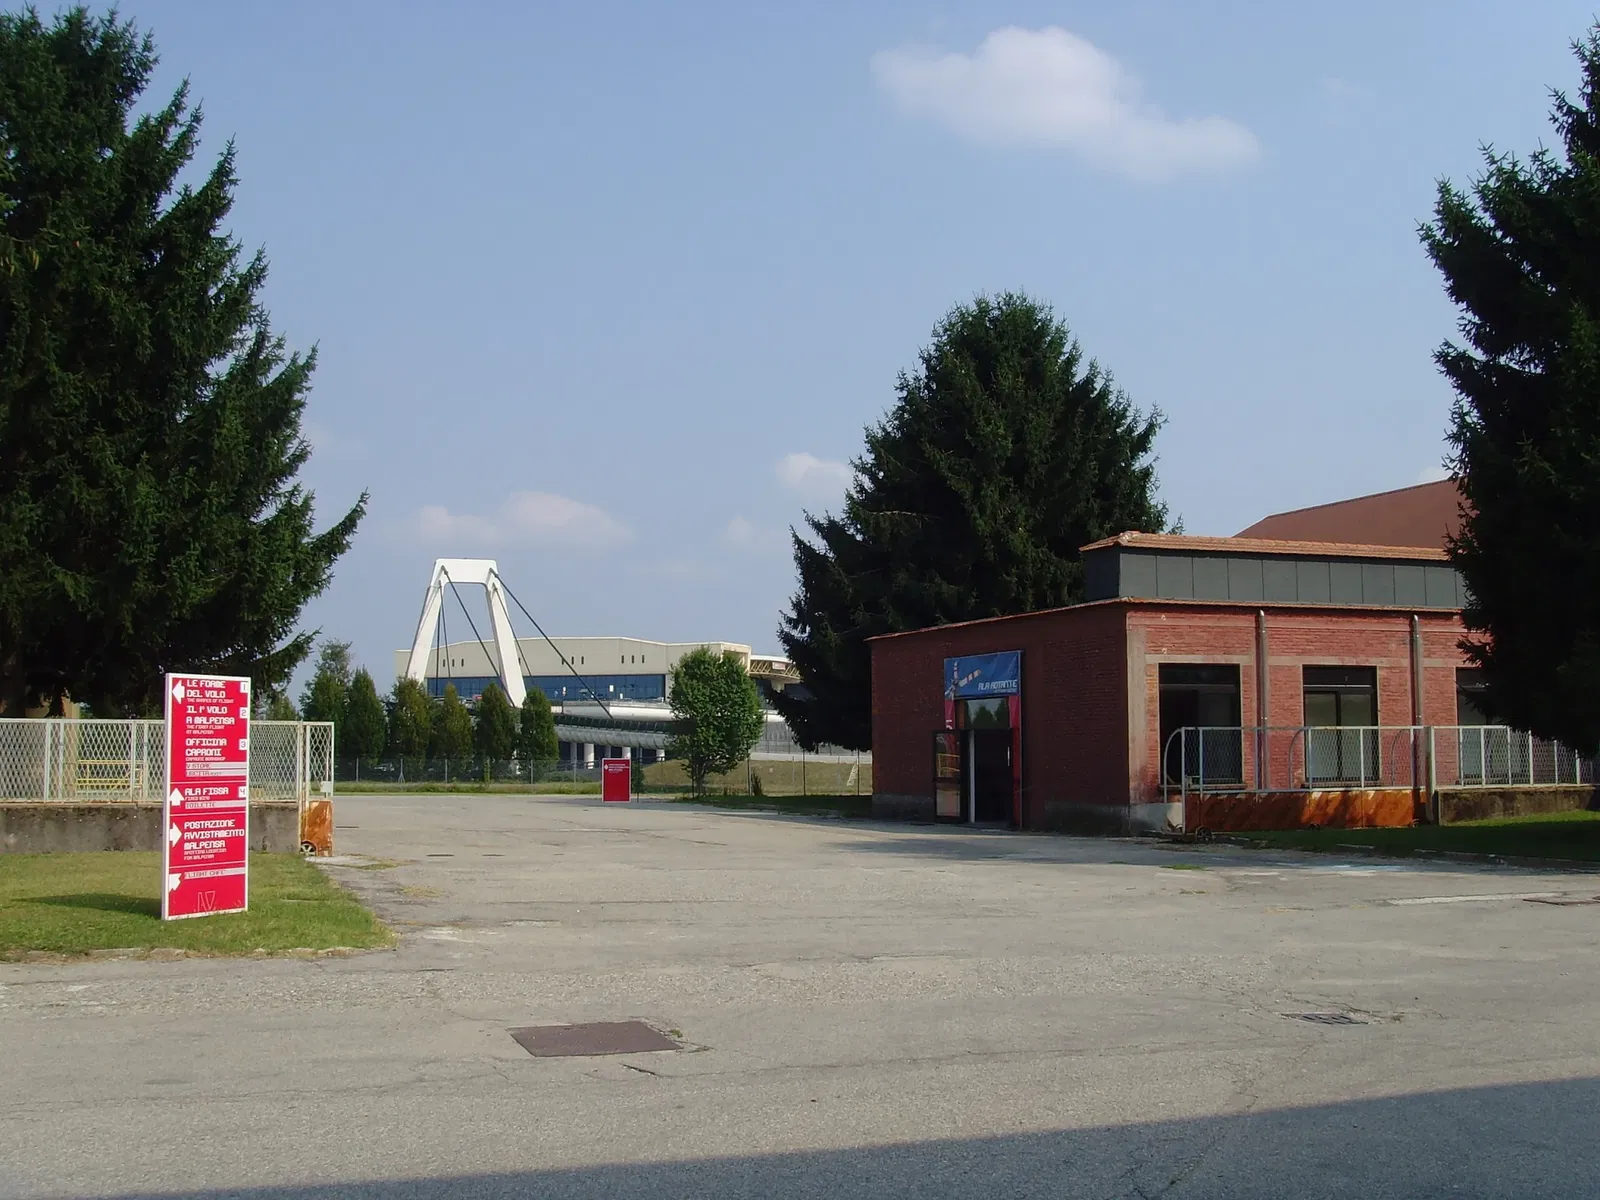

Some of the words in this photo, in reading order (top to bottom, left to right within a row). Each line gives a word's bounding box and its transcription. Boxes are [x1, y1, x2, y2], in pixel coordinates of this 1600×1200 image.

[186, 680, 198, 688] LE
[978, 682, 990, 690] ALA
[991, 680, 1017, 689] ROTANTE
[205, 690, 226, 698] VOLO
[186, 706, 198, 714] IL
[206, 706, 228, 714] VOLO
[186, 716, 193, 724] A
[194, 716, 235, 725] MALPENSA
[186, 738, 228, 746] OFFICINA
[185, 748, 222, 757] CAPRONI
[185, 788, 201, 796] ALA
[202, 787, 229, 795] FISSA
[184, 820, 236, 830] POSTAZIONE
[184, 829, 245, 840] AVVISTAMENTO
[184, 840, 226, 850] MALPENSA
